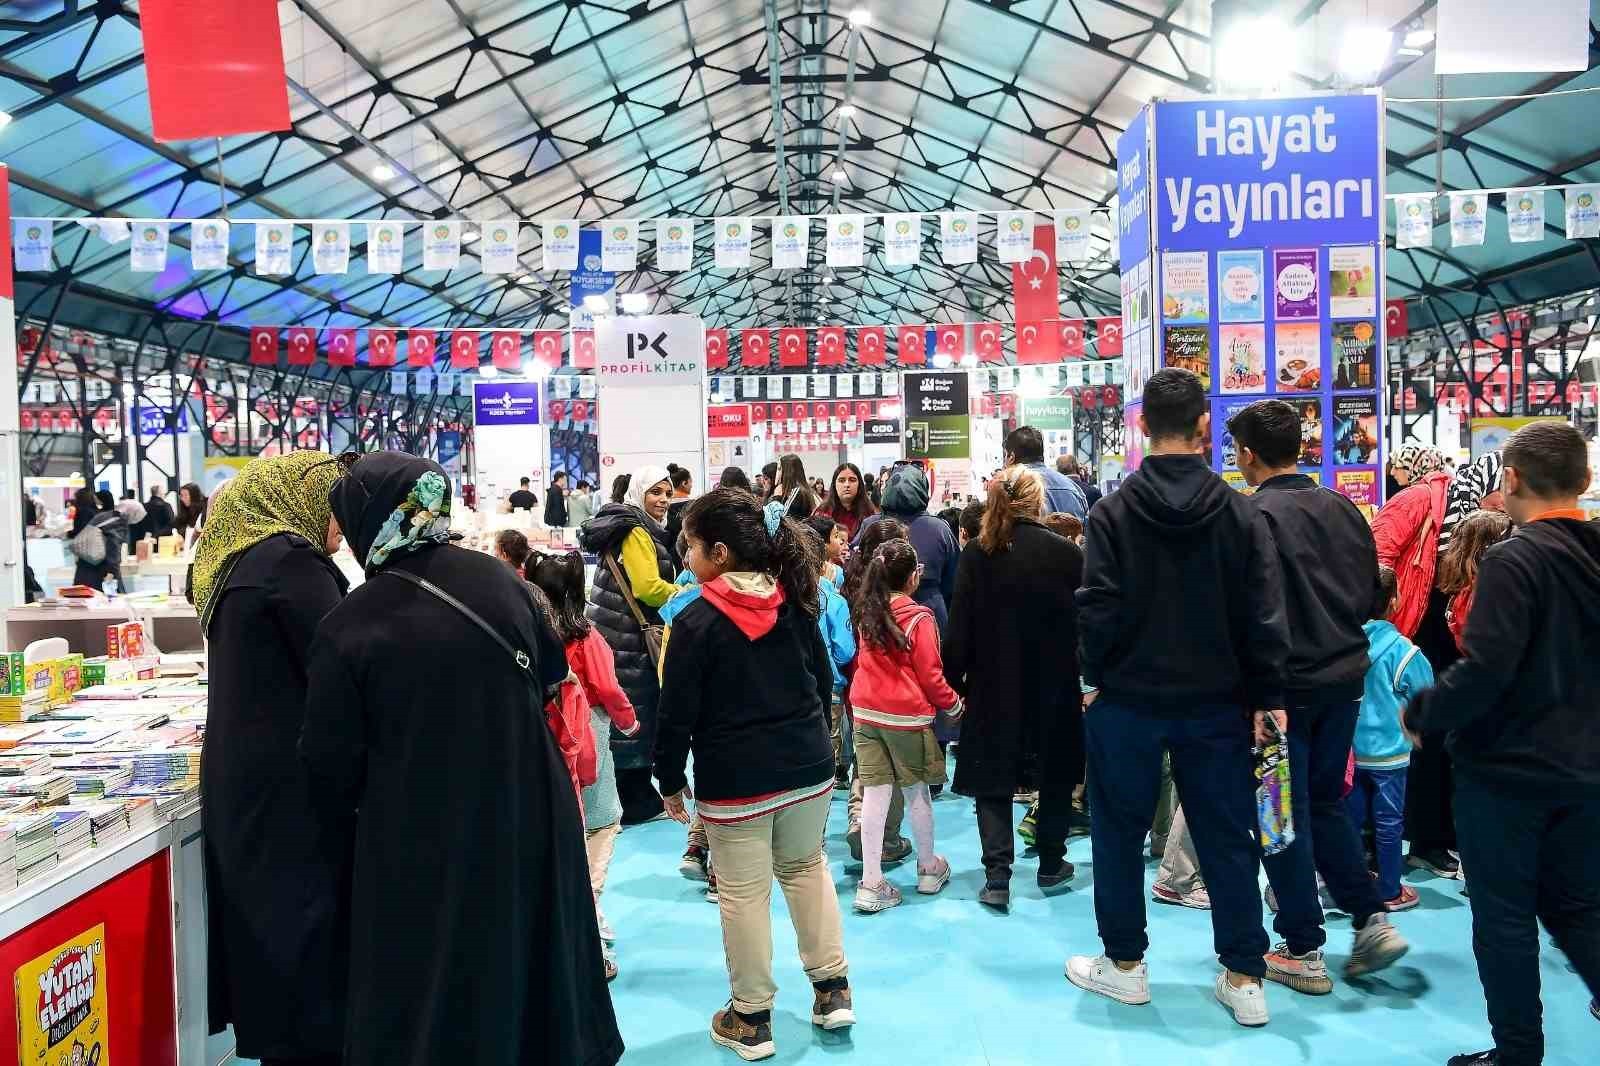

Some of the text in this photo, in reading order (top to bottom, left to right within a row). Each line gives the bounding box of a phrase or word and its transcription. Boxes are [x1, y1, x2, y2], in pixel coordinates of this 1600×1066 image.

[1196, 105, 1336, 171] Hayat
[1122, 149, 1141, 193] Hayat
[39, 944, 94, 1005] YUTAN
[40, 975, 94, 1033] ELEMAN
